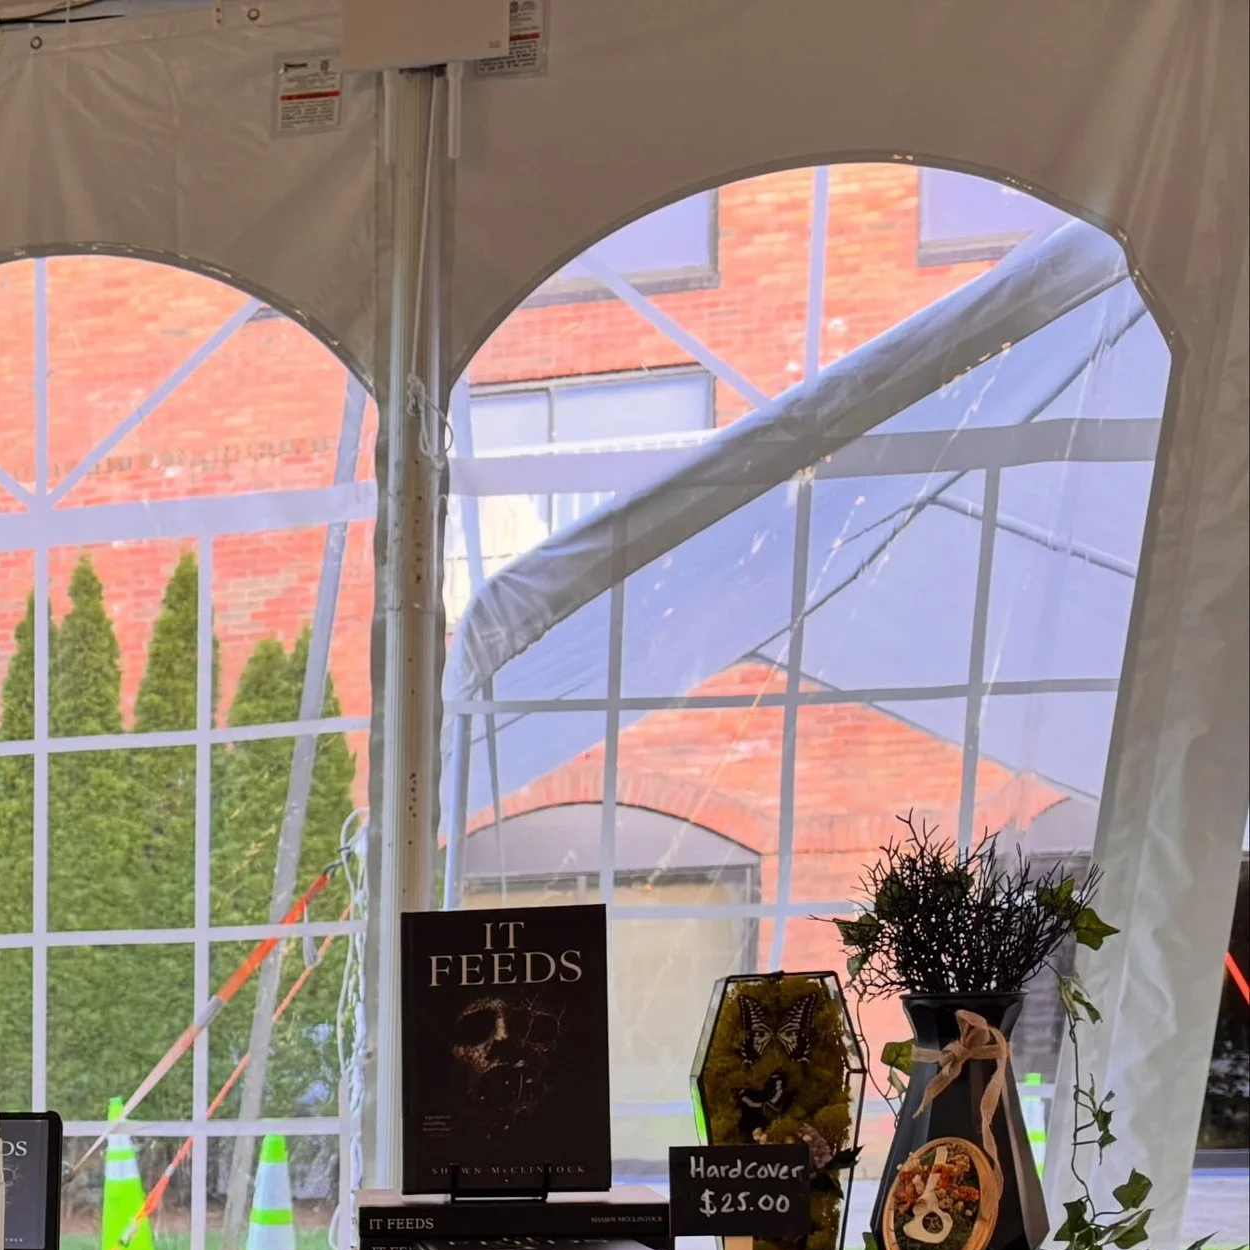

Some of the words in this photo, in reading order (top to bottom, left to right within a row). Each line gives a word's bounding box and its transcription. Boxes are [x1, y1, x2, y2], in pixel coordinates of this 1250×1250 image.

[483, 921, 525, 950] IT
[428, 950, 583, 988] FEEDS
[431, 1166, 481, 1175] SHWN
[699, 1188, 790, 1217] $25.00
[369, 1218, 384, 1230] IT
[387, 1217, 435, 1230] FEEDS
